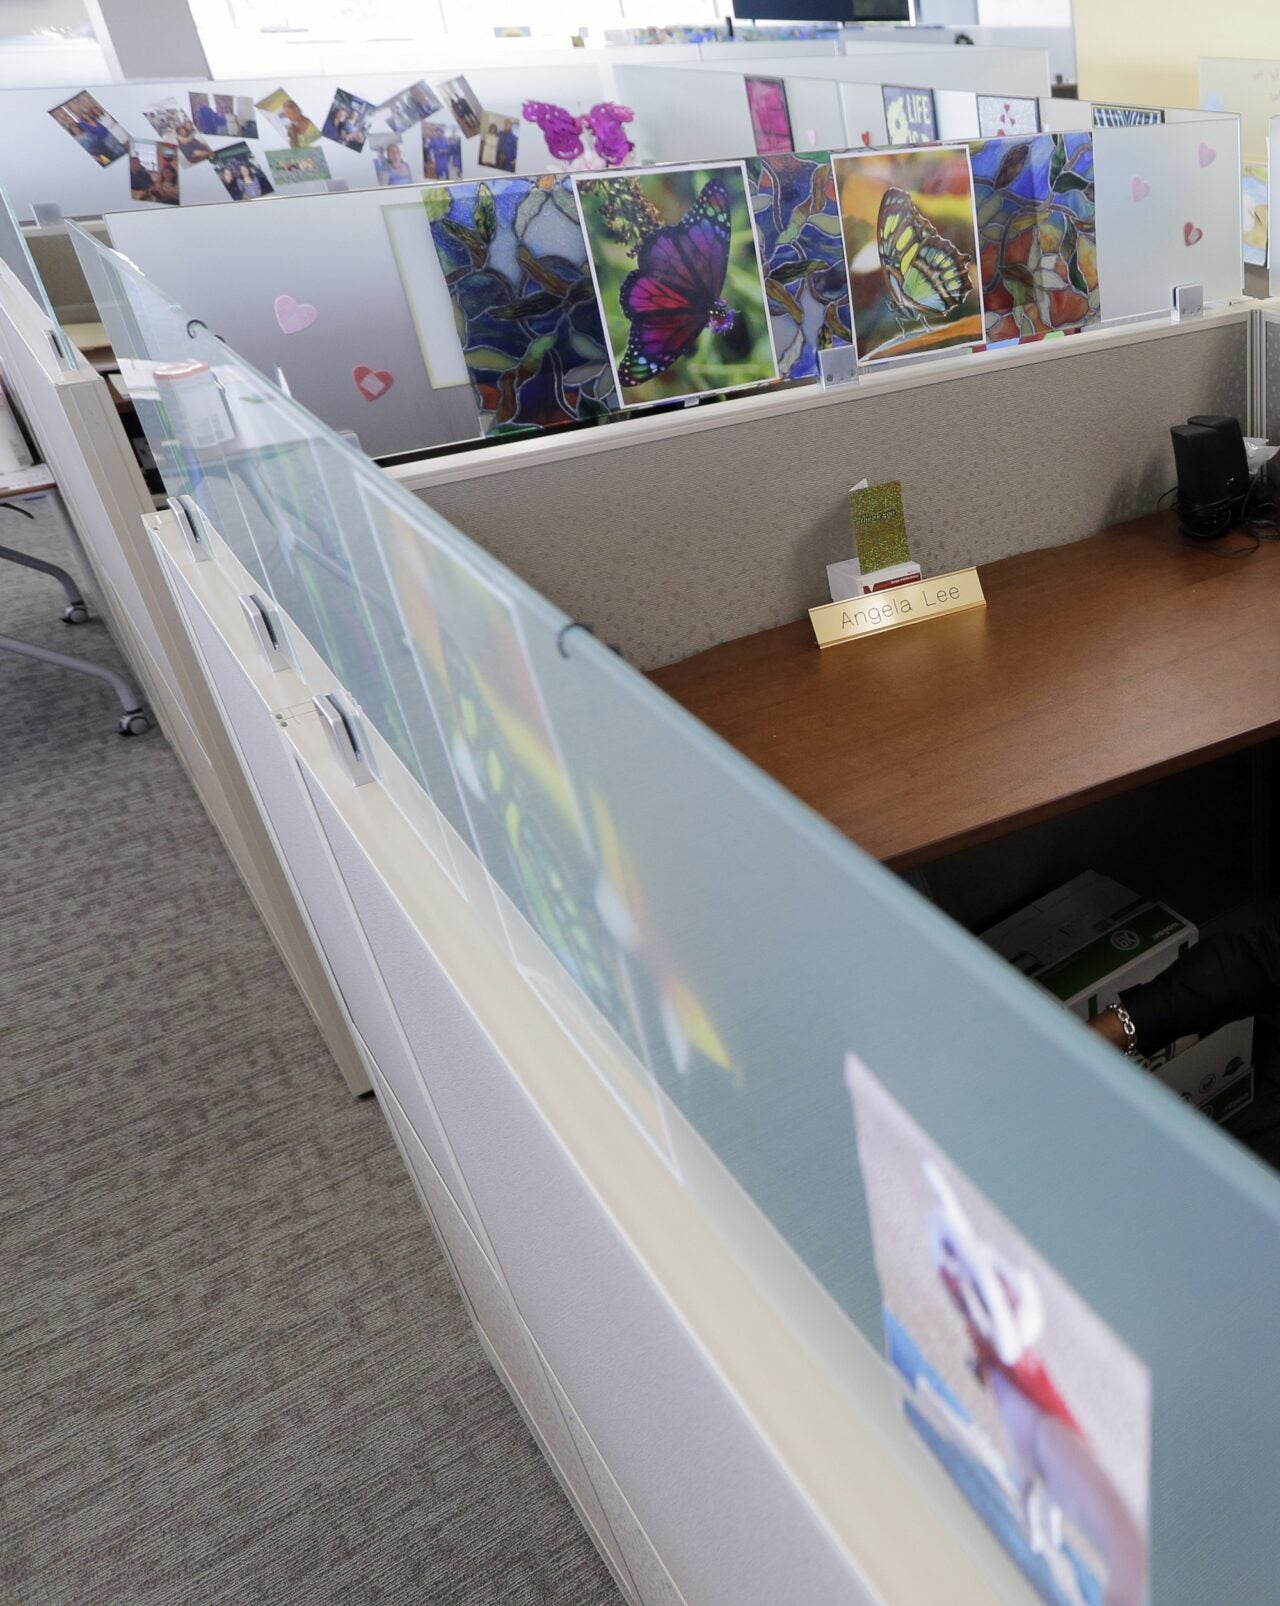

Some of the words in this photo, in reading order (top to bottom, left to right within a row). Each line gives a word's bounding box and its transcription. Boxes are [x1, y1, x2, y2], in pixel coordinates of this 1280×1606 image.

[906, 94, 931, 124] LIFE
[841, 598, 913, 630] Angela
[922, 585, 961, 607] Lee
